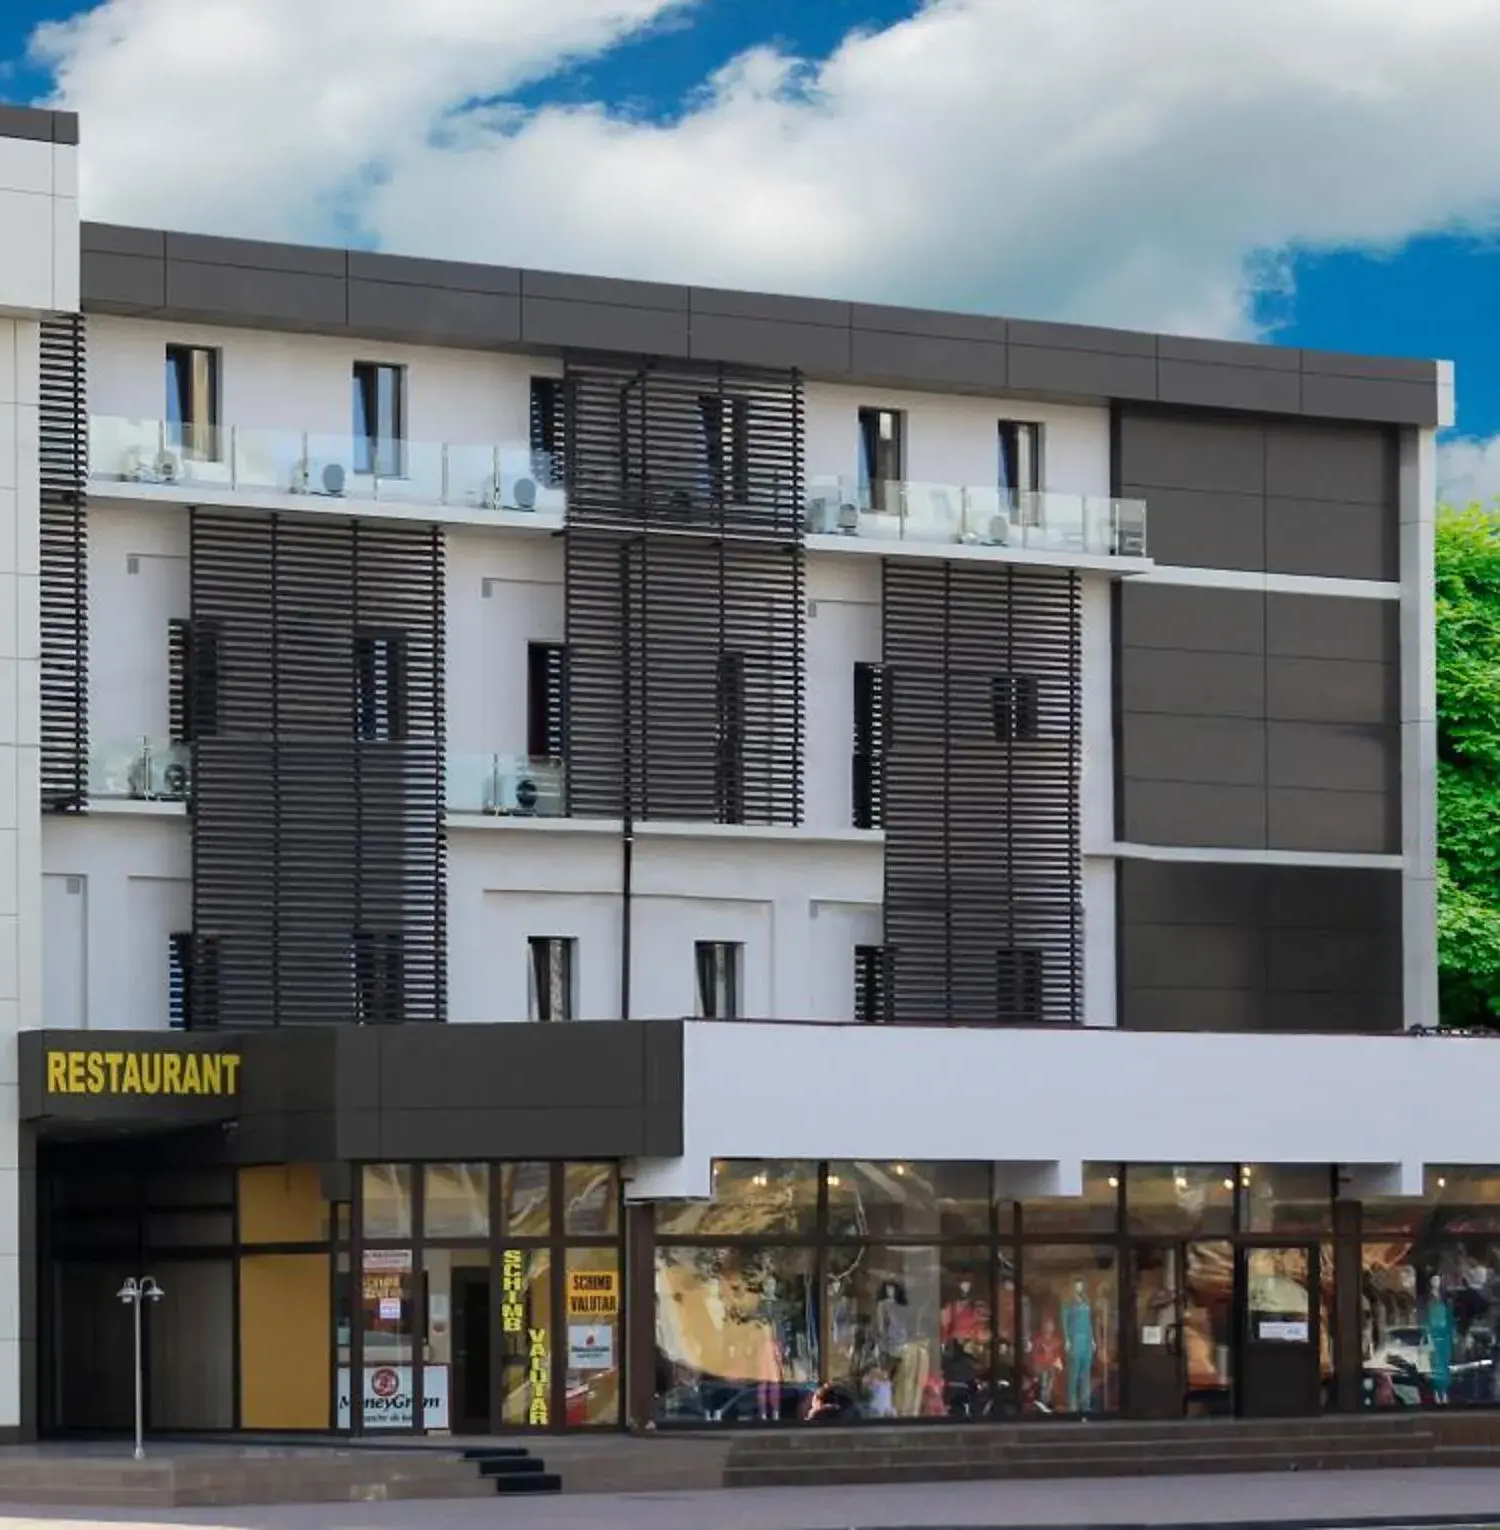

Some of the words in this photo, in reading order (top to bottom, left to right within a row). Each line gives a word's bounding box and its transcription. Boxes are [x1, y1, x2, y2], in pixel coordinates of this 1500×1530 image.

[48, 1052, 241, 1094] RESTAURANT
[573, 1275, 612, 1290] SCHIMB
[570, 1296, 616, 1312] VALUTAR
[502, 1250, 523, 1332] SCHIMB
[528, 1328, 549, 1425] VALUTAR
